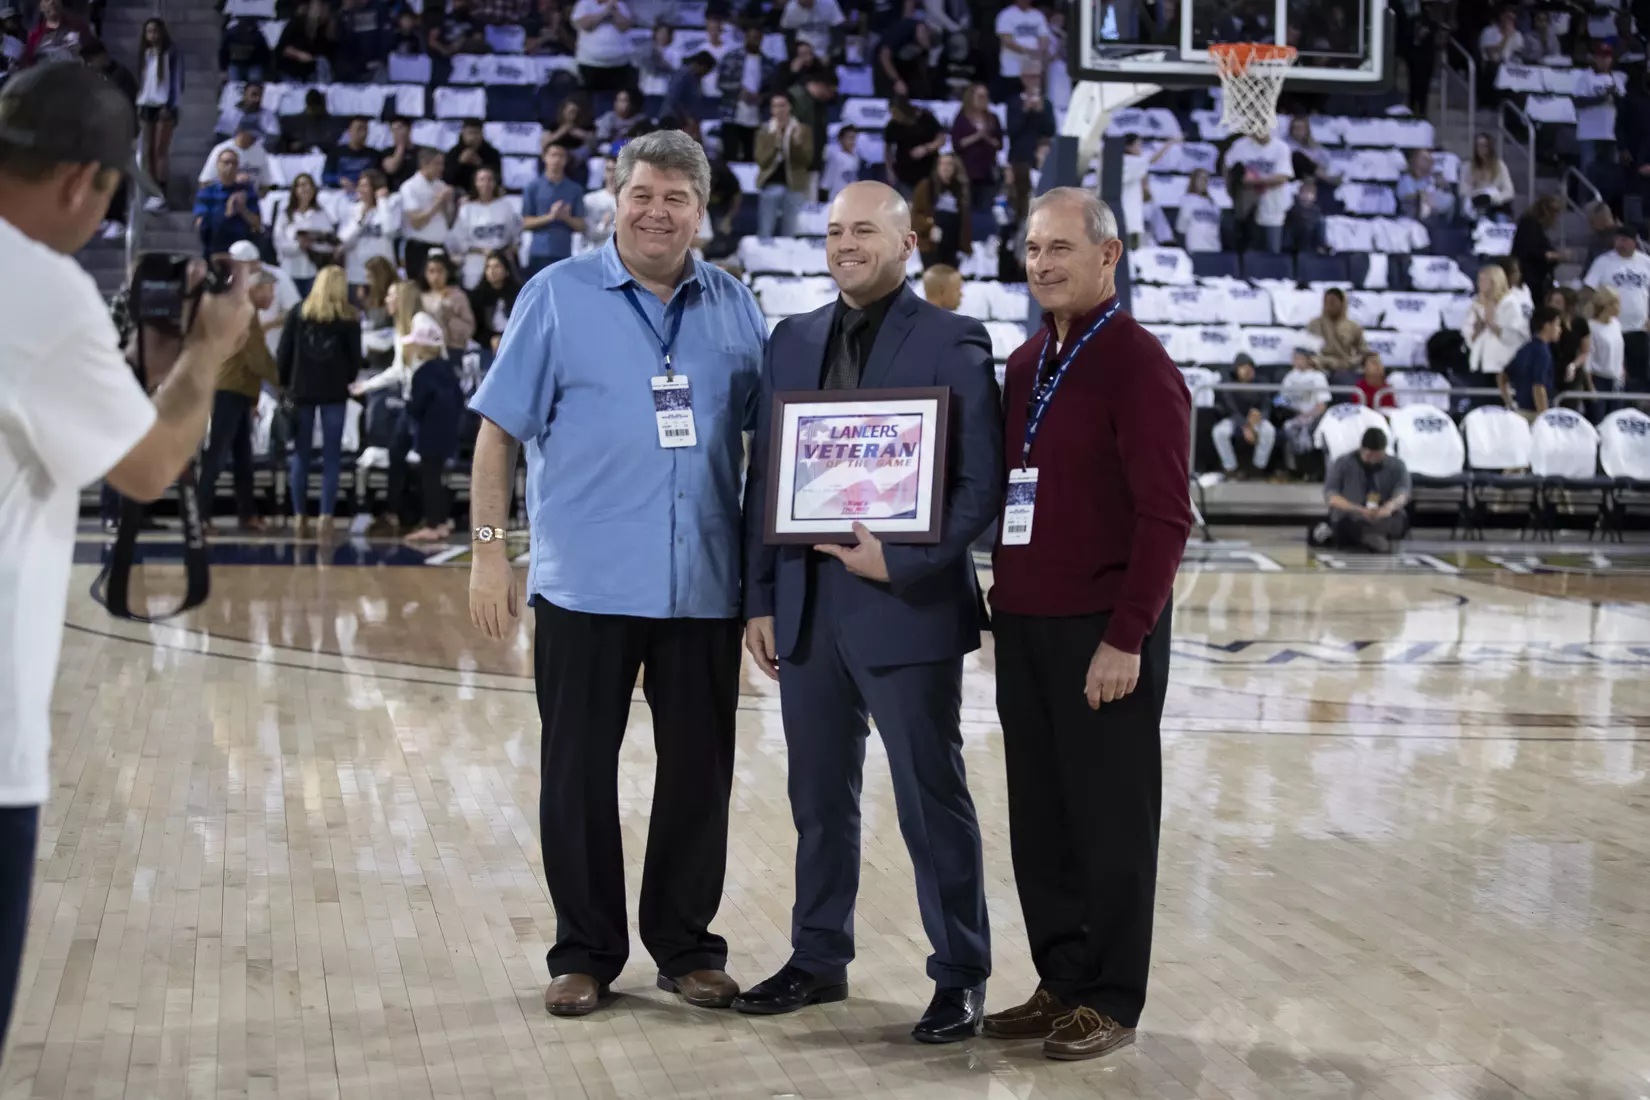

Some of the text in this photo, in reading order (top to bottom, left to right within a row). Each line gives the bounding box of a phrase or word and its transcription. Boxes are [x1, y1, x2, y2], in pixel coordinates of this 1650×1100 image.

[830, 424, 898, 439] LANCERS
[804, 442, 917, 459] VETERAN
[826, 458, 913, 468] OF THE GAME
